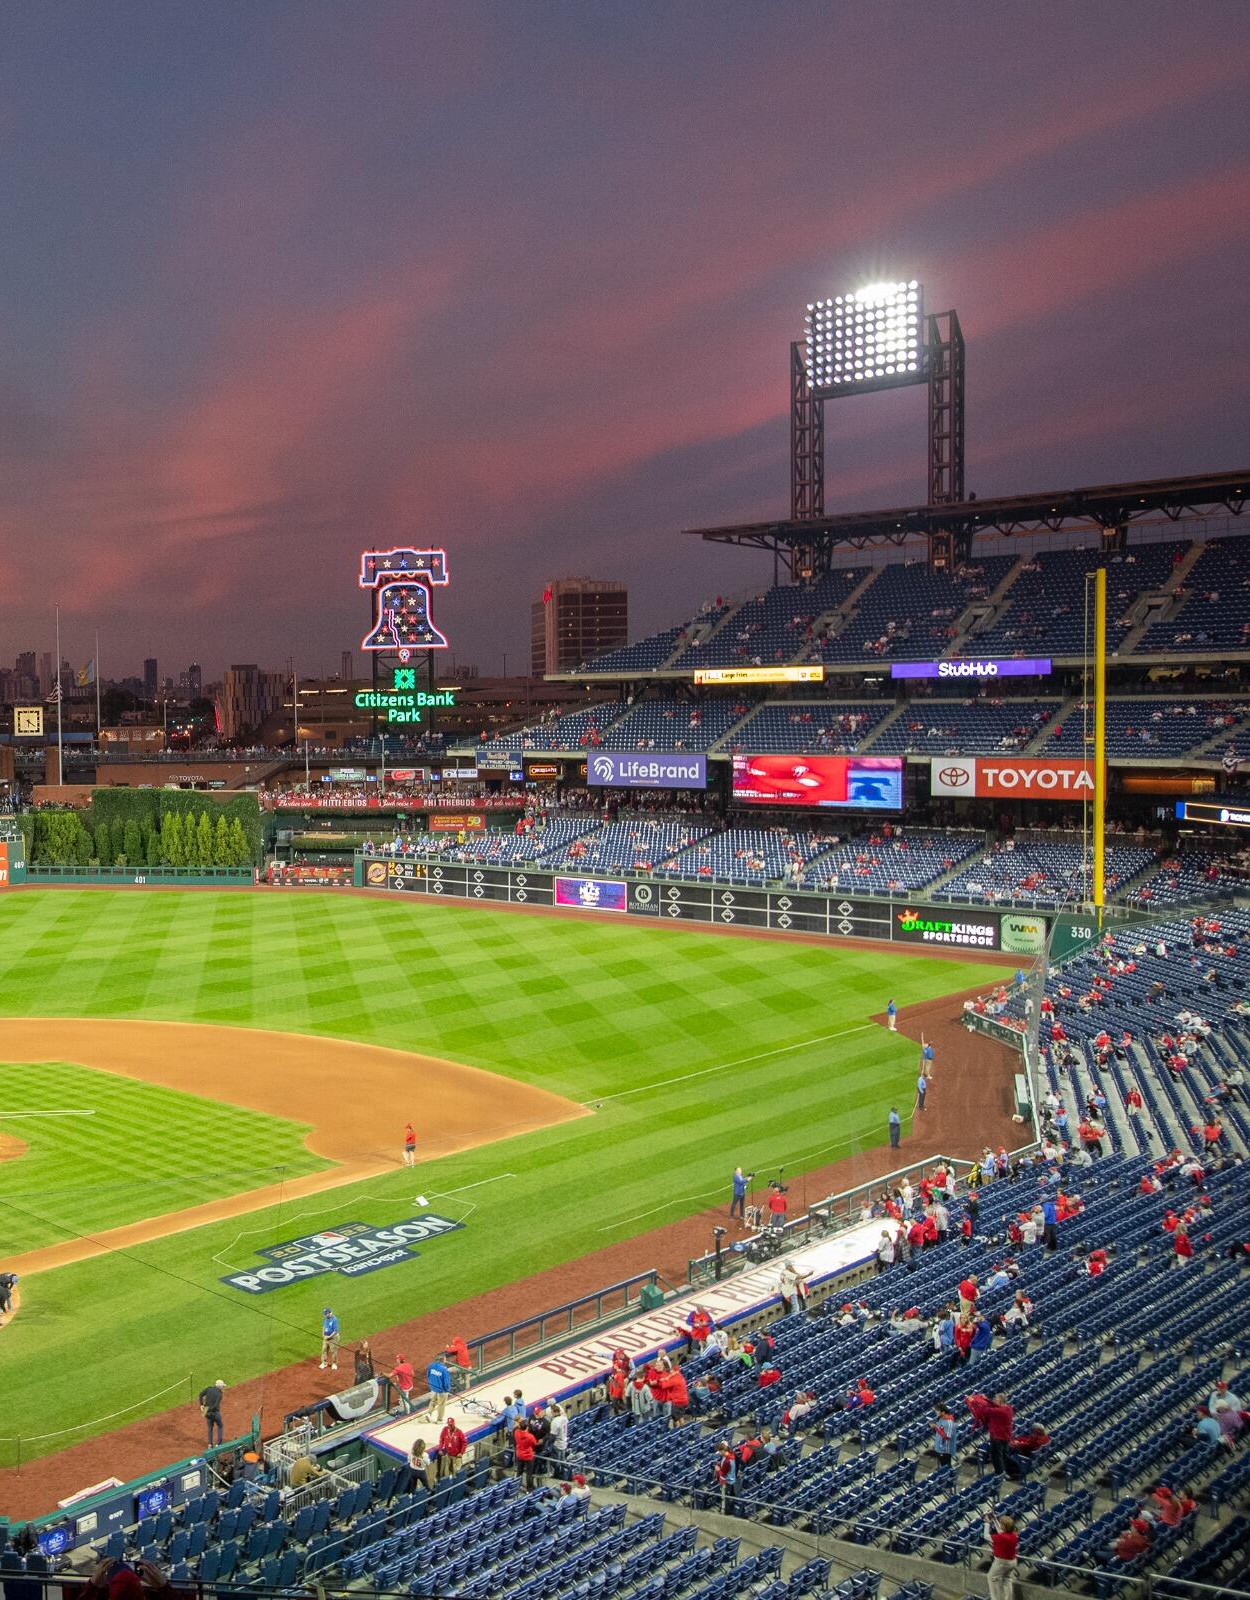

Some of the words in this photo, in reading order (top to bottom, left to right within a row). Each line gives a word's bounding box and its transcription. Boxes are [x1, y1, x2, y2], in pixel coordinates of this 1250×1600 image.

[938, 661, 998, 677] StubHub
[355, 693, 414, 707] Citizens
[417, 692, 454, 706] Bank
[388, 709, 421, 722] Park
[618, 761, 699, 779] LifeBrand
[982, 768, 1095, 790] TOYOTA
[134, 876, 146, 884] 401
[923, 931, 994, 946] SPORTSBOOK
[1071, 926, 1091, 939] 330
[230, 1215, 457, 1291] POSTSEASON
[341, 1248, 408, 1275] loanDepot
